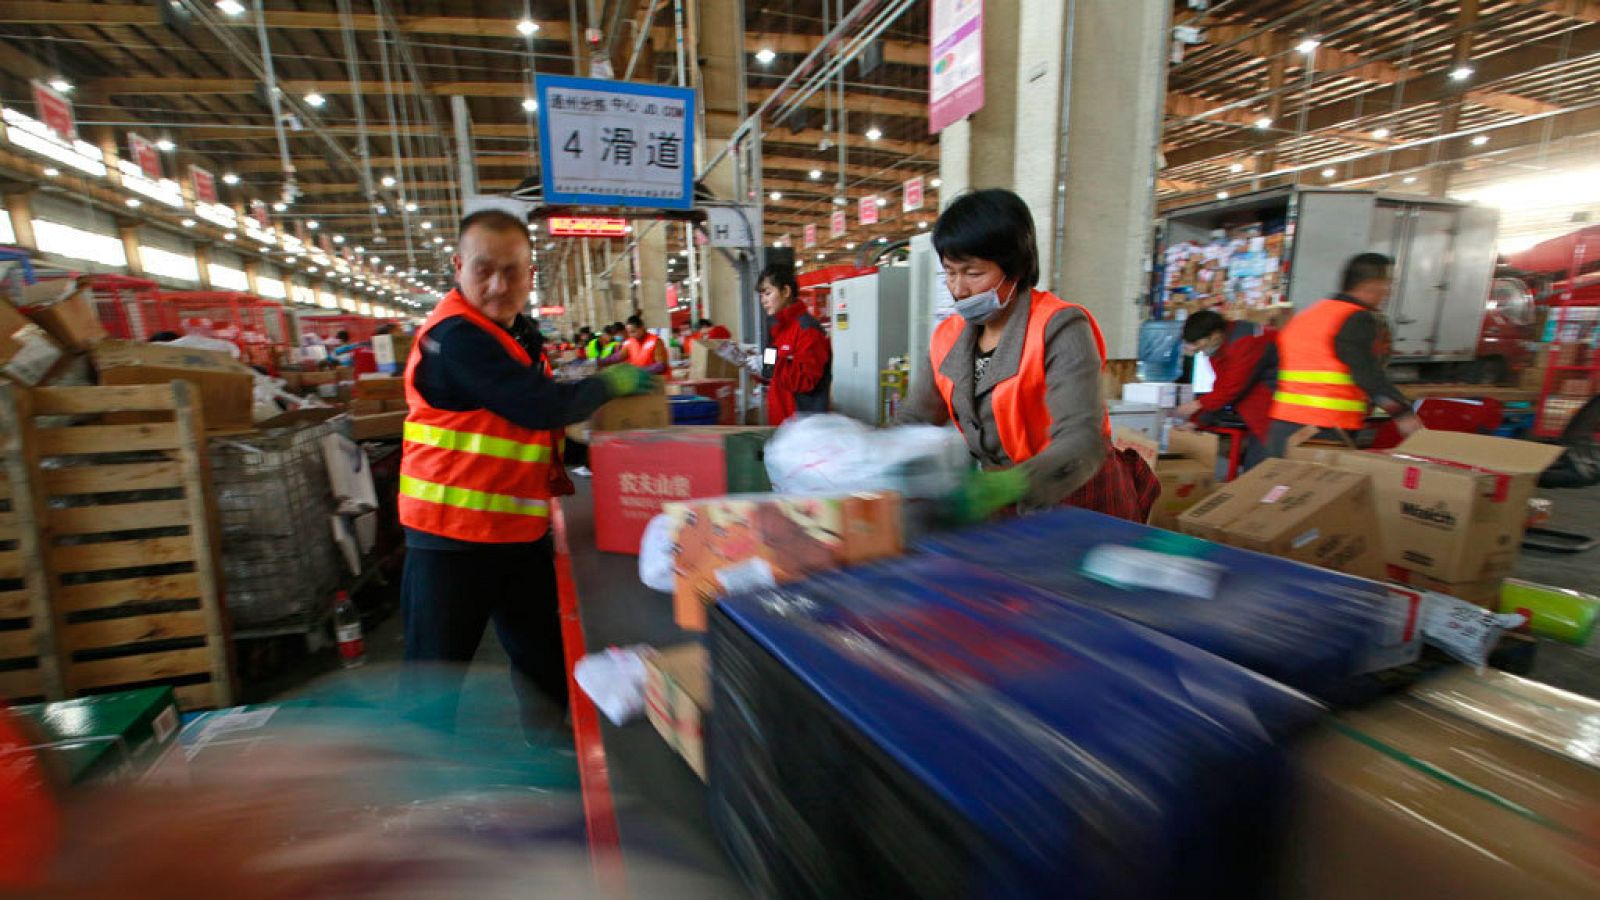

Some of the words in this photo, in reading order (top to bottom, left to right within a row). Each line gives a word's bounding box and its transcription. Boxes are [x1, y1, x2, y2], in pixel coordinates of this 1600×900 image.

[563, 129, 584, 160] 4
[601, 127, 682, 170] 滑道
[714, 224, 729, 240] H
